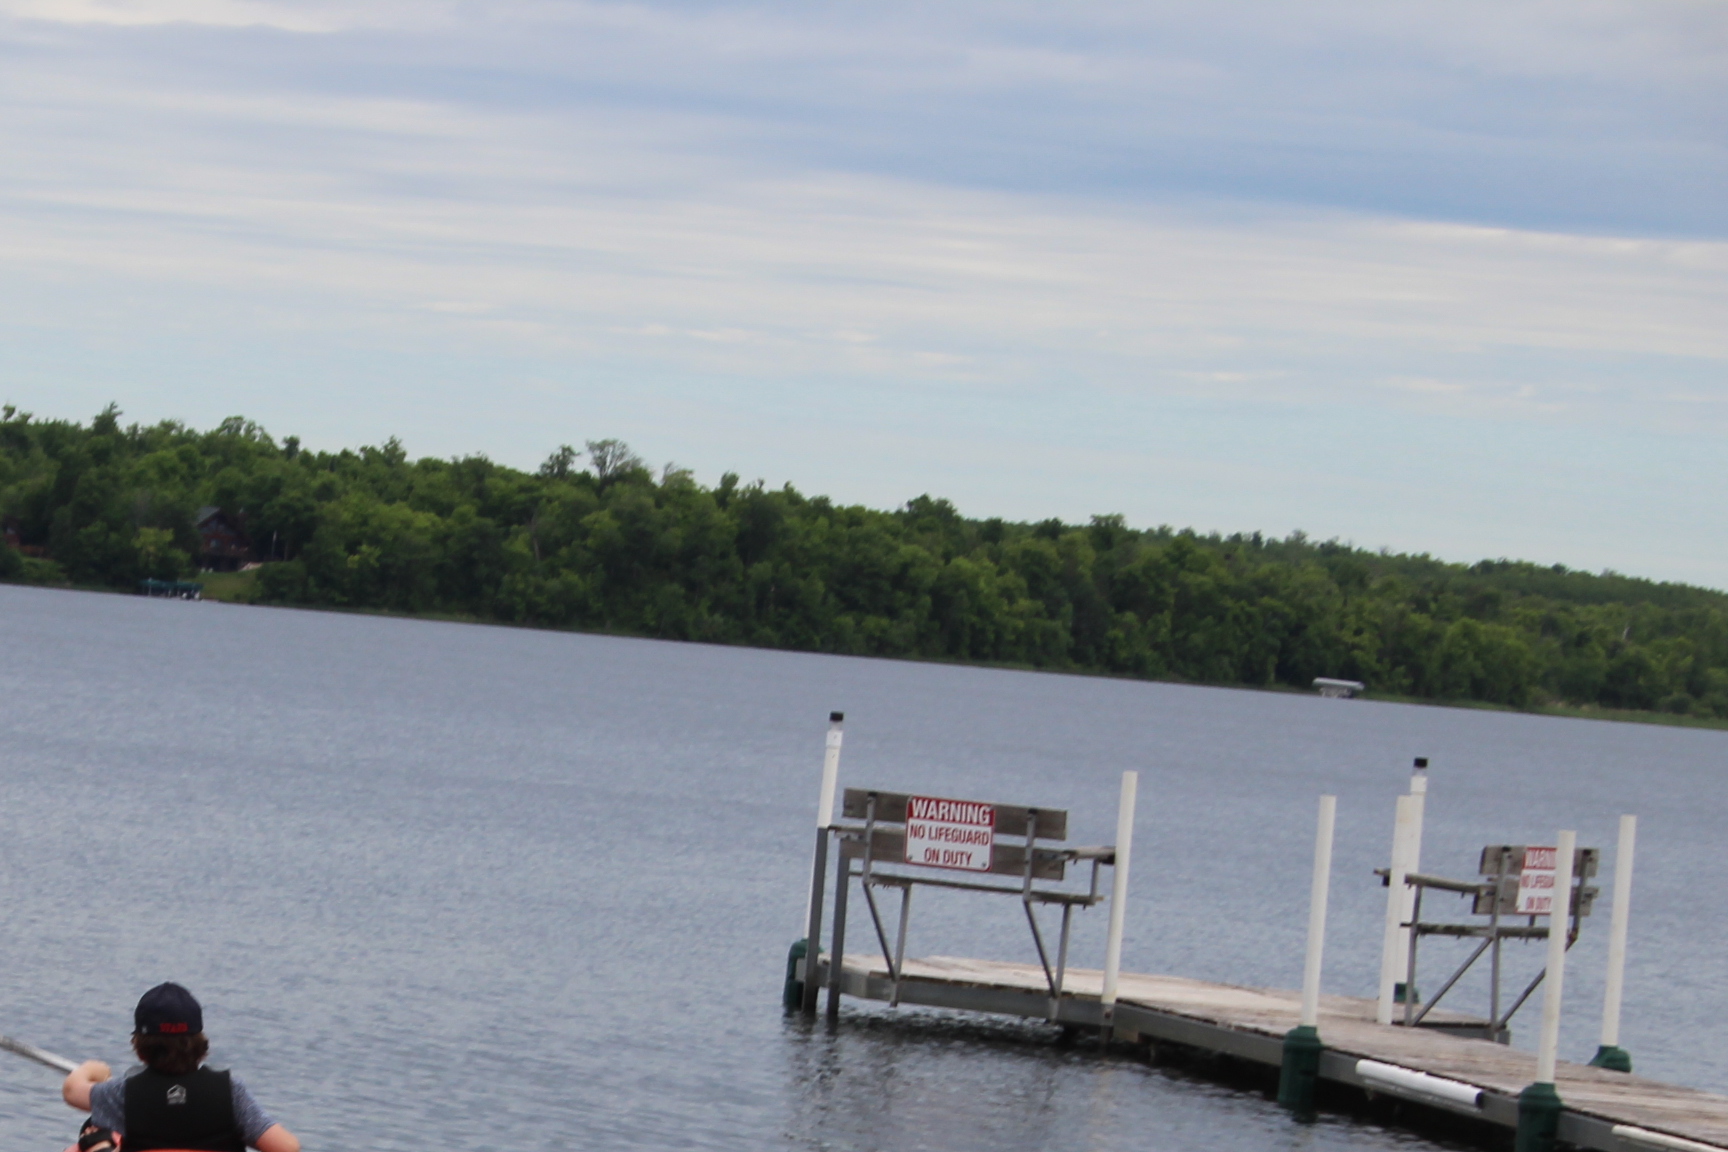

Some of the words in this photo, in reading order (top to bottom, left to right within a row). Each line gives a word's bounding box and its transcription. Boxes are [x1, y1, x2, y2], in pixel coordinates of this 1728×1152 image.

[912, 798, 990, 825] WARNING
[909, 824, 925, 839] NO
[928, 825, 989, 846] LIFEGUARD
[924, 847, 939, 863] ON
[942, 849, 973, 866] DUTY
